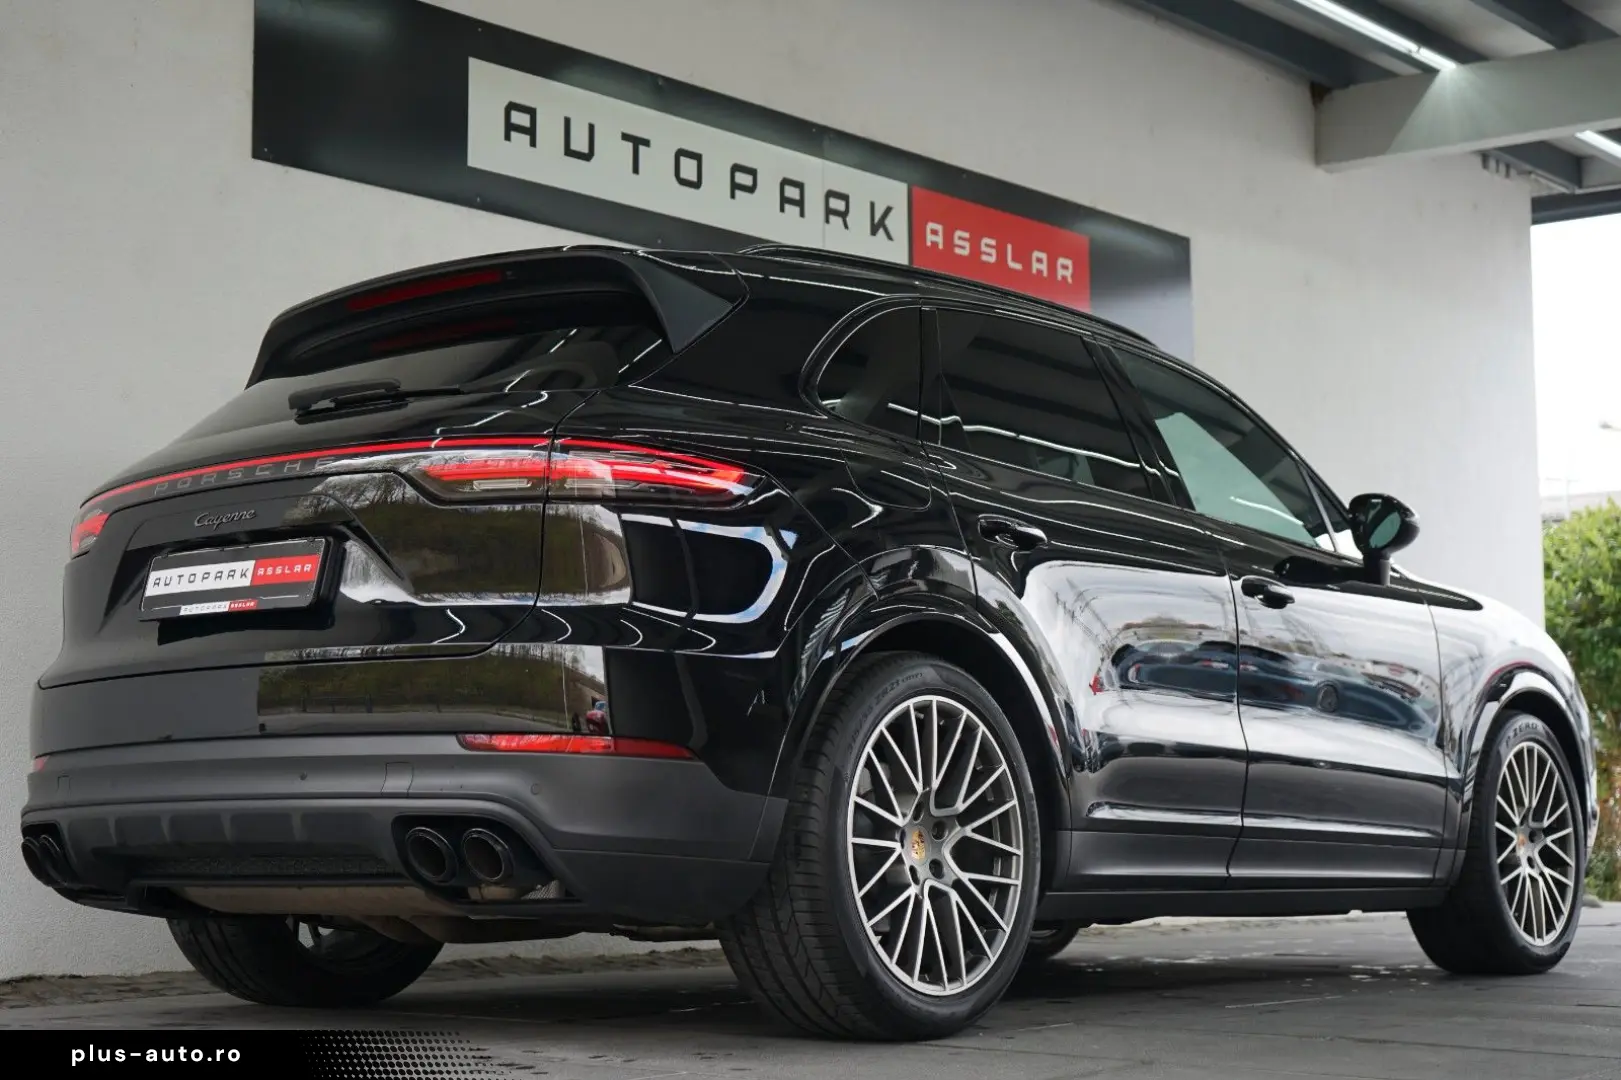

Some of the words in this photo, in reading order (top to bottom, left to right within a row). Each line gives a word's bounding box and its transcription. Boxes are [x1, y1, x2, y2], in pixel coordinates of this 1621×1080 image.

[504, 101, 894, 241] AUTOPARK
[926, 222, 1072, 284] ASSLAR
[154, 457, 334, 495] PORSCHE
[194, 509, 256, 530] Cayenne
[153, 568, 249, 588] AUTOPARK
[257, 564, 312, 577] ASSLAR
